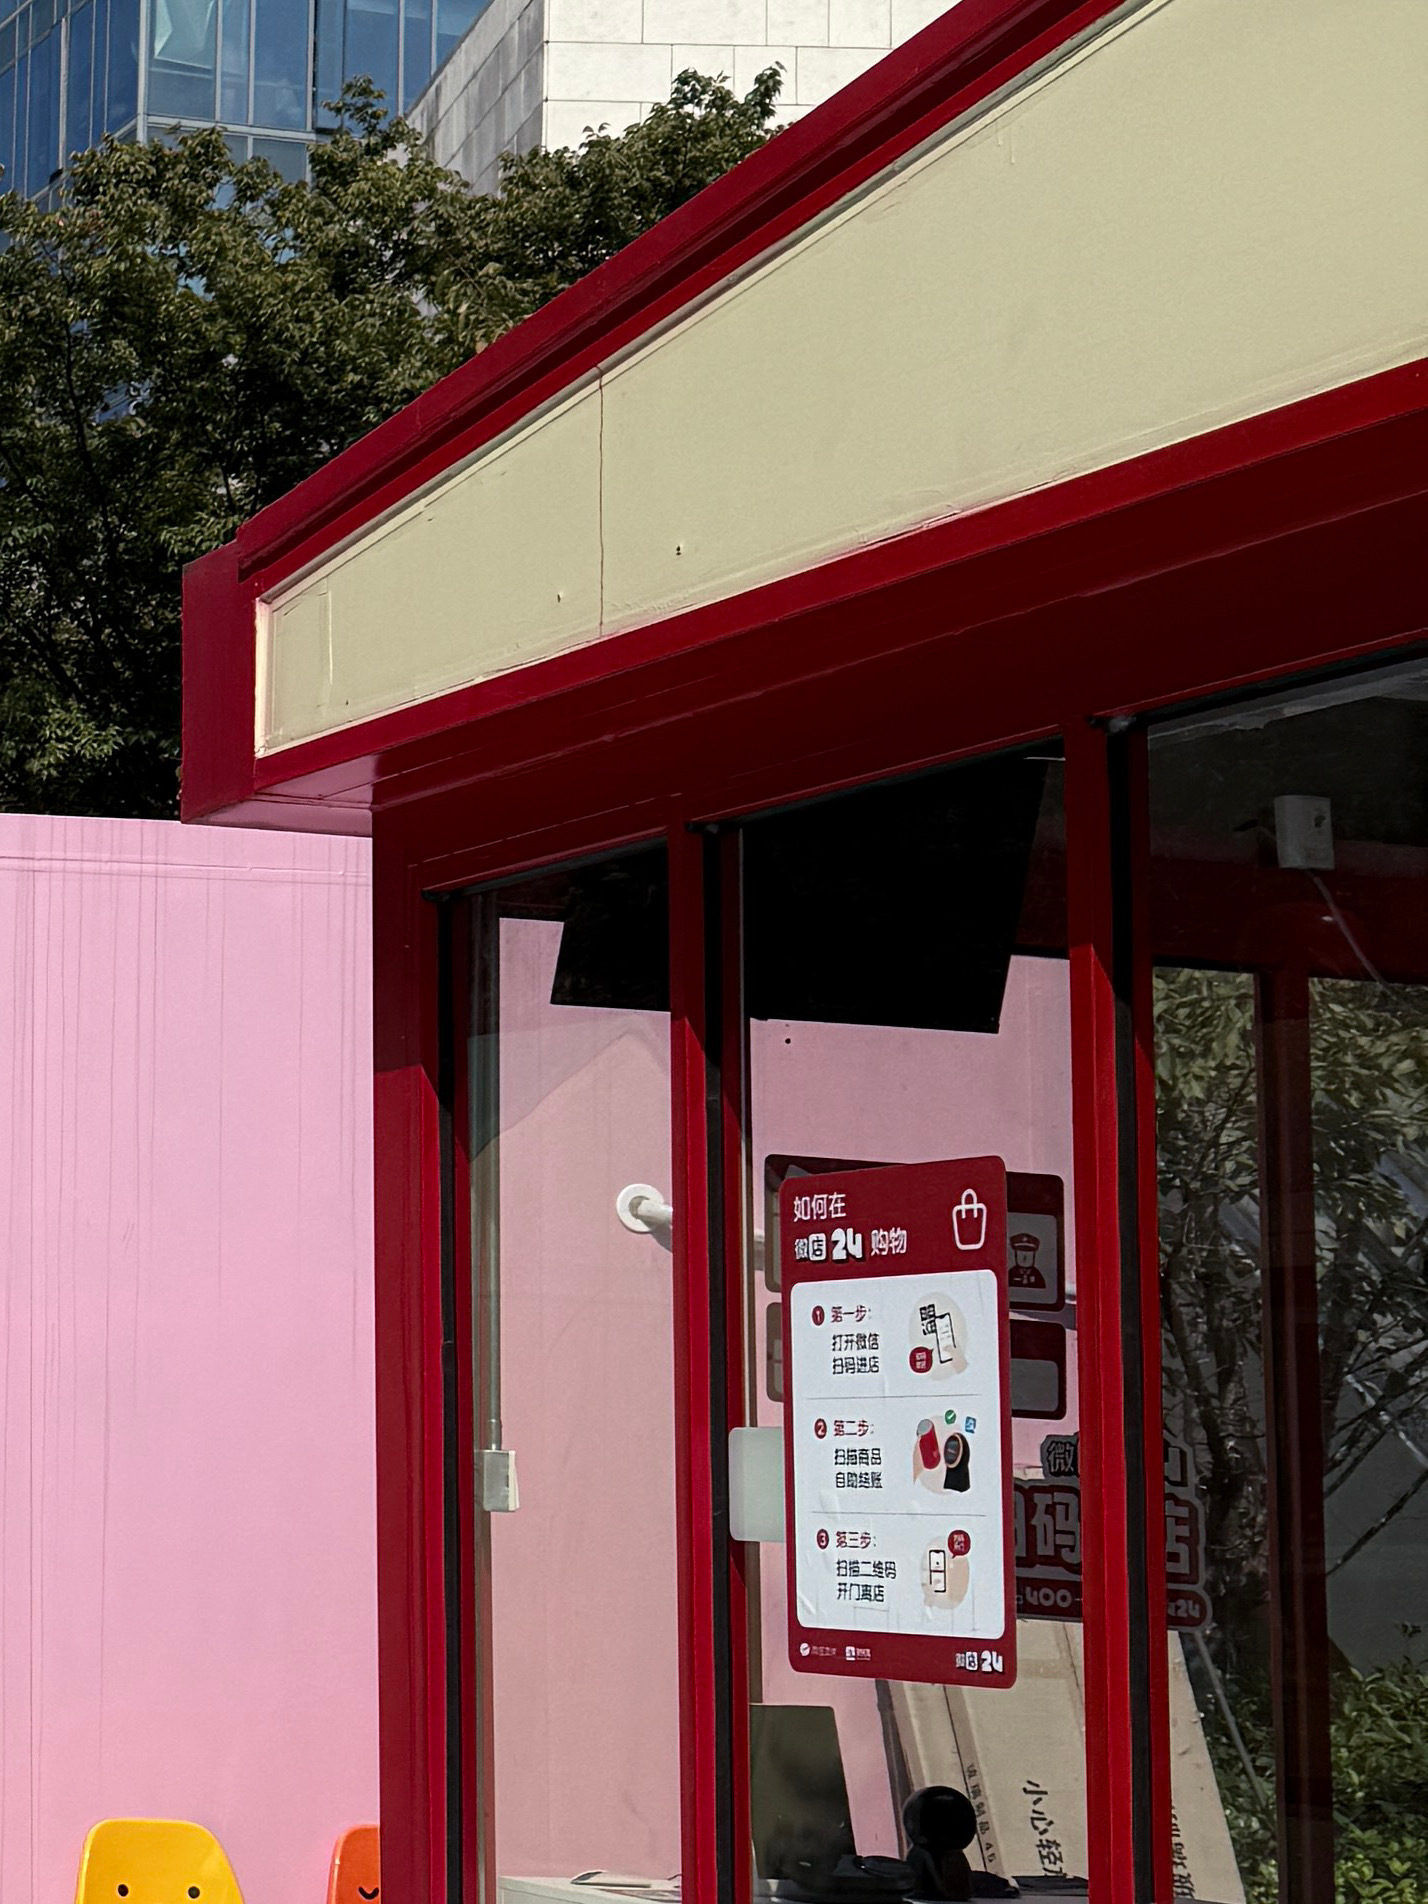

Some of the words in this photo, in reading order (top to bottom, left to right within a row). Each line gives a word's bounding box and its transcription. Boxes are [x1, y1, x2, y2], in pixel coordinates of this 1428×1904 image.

[793, 1192, 847, 1222] 如何在
[871, 1227, 907, 1256] 购物
[832, 1333, 880, 1352] 打开微信
[832, 1356, 880, 1375] 扫码进店
[834, 1448, 882, 1466] 扫描商品
[835, 1471, 883, 1489] 自助结账
[836, 1559, 897, 1580] 扫描二维码
[836, 1582, 885, 1602] 开门离店
